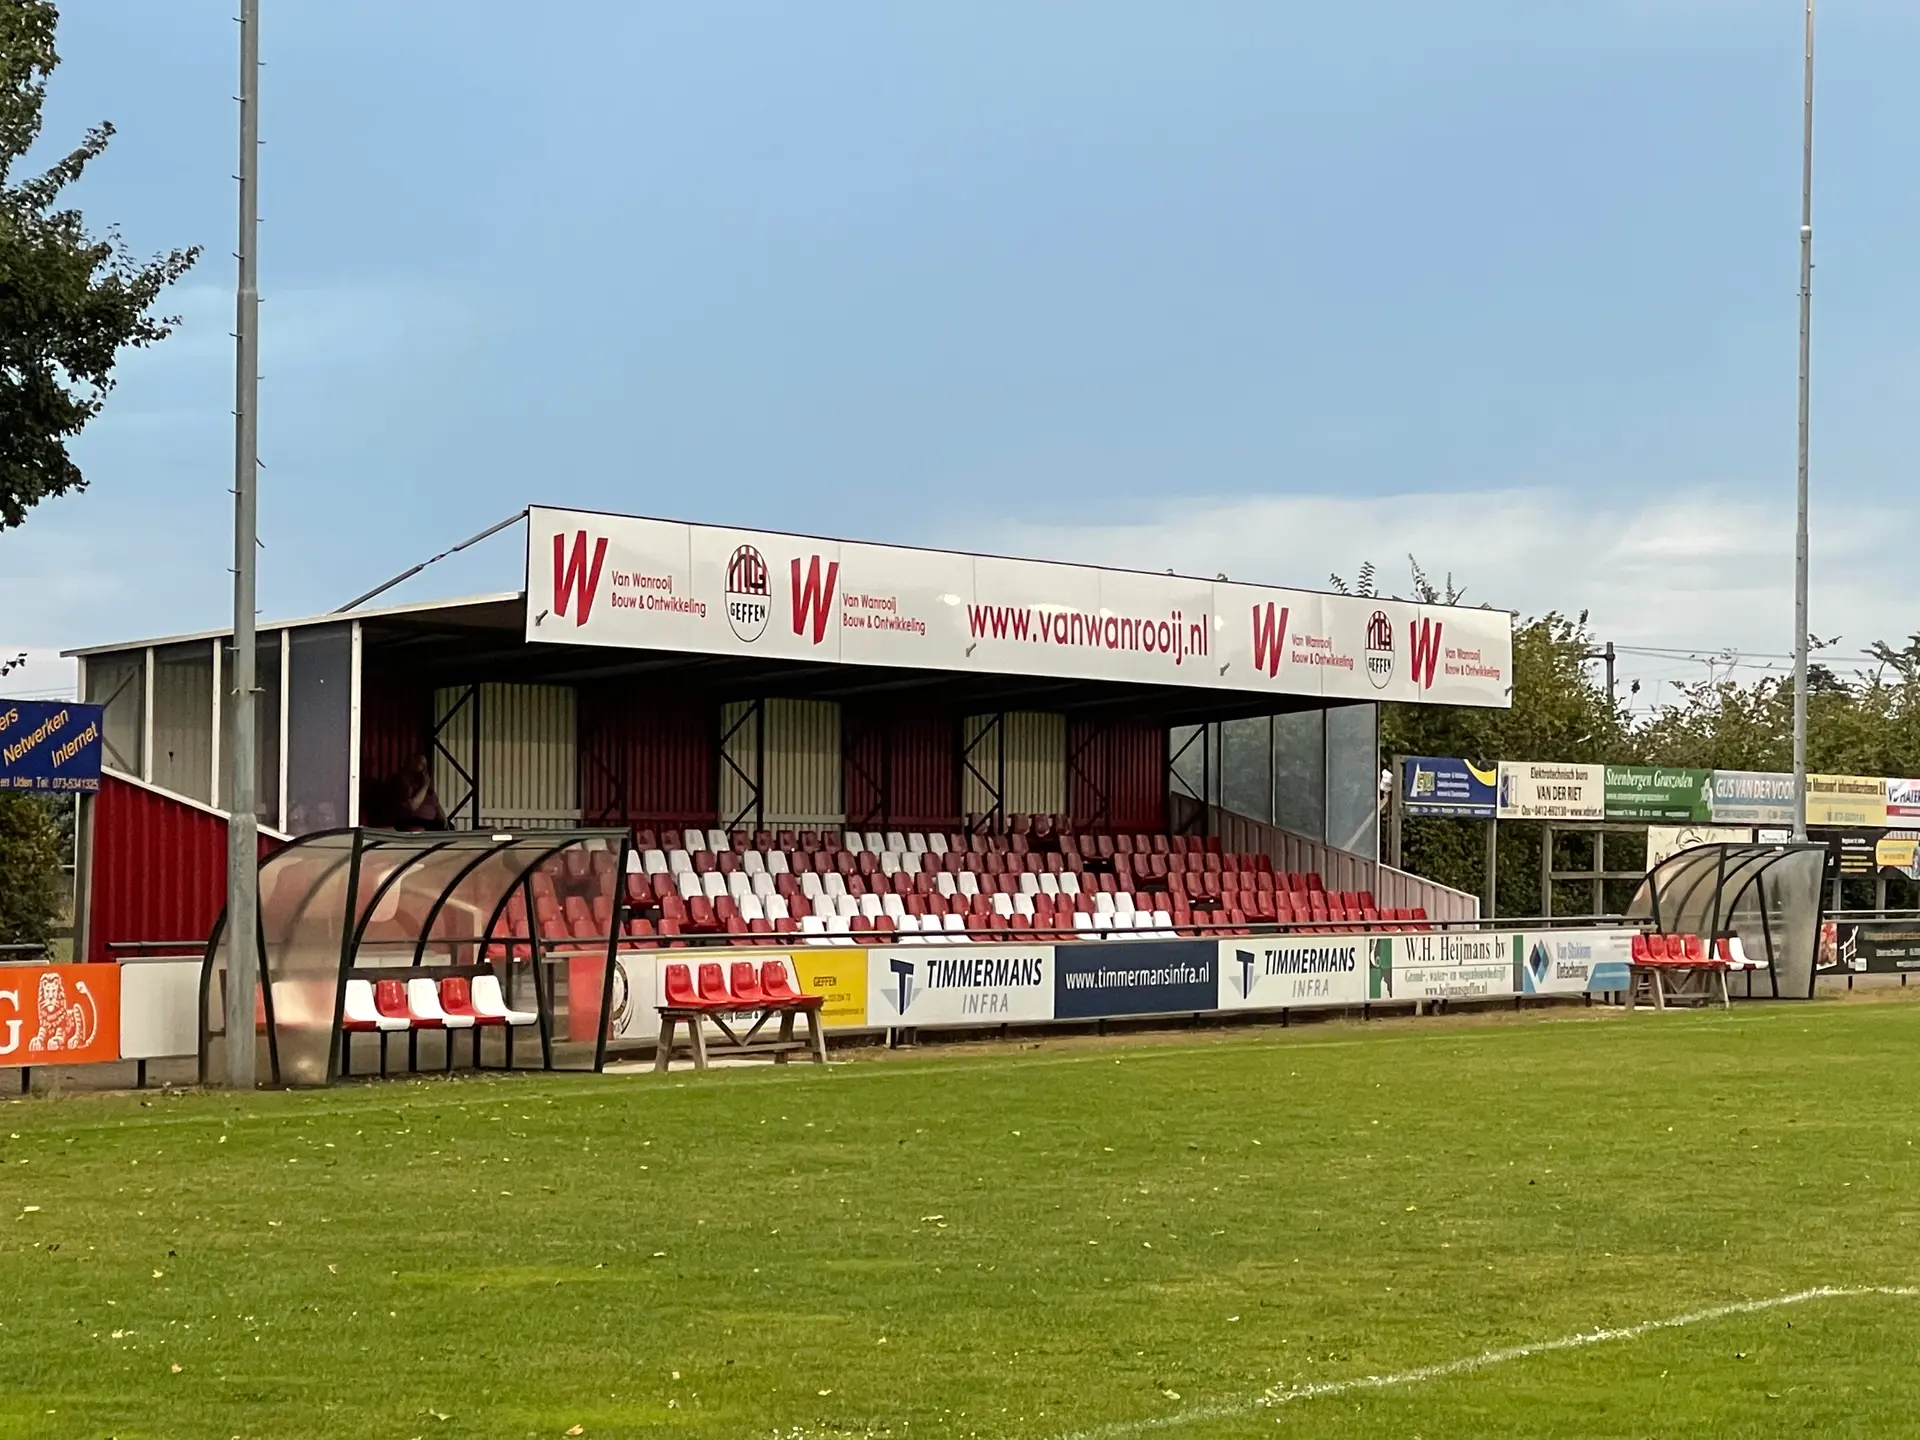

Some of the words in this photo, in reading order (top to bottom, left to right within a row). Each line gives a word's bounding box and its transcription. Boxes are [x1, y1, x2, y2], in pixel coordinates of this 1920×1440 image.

[612, 570, 629, 586] Van
[632, 572, 672, 594] Wanrooij
[612, 592, 636, 608] Bouw
[639, 595, 645, 609] &
[647, 596, 706, 618] Ontwikkeling
[730, 602, 766, 624] GEFFEN
[842, 593, 859, 607] Van
[861, 594, 897, 614] Wanrooij
[843, 613, 865, 628] Bouw
[867, 616, 873, 629] &
[874, 616, 926, 636] Ontwikkeling
[968, 604, 1208, 665] www.vanwanrooij.nl
[1292, 634, 1304, 647] Van
[1305, 634, 1332, 650] Wanrooij
[1292, 651, 1309, 664] Bouw
[1315, 652, 1354, 670] Ontwikkeling
[1368, 657, 1391, 674] GEFFEN
[1445, 648, 1455, 660] Van
[1457, 649, 1481, 662] Wanrooij
[1445, 663, 1459, 676] Bouw
[1466, 665, 1500, 680] Ontwikkeling
[3, 709, 70, 767] Netwerken
[51, 721, 98, 768] Internet
[1606, 768, 1652, 791] Steenbergen
[1735, 780, 1753, 798] VAN
[1754, 780, 1771, 799] DER
[1537, 785, 1551, 800] VAN
[1553, 786, 1566, 800] DER
[1568, 787, 1582, 801] RIET
[1265, 947, 1356, 975] TIMMERMANS
[1405, 937, 1435, 961] W.H.
[1441, 936, 1490, 966] Heijmans
[1495, 935, 1506, 958] bv
[813, 976, 837, 987] GEFFEN
[927, 958, 1042, 989] TIMMERMANS
[1066, 962, 1210, 989] www.timmermansinfra.nl
[1292, 979, 1330, 998] INFRA
[962, 993, 1009, 1014] INFRA
